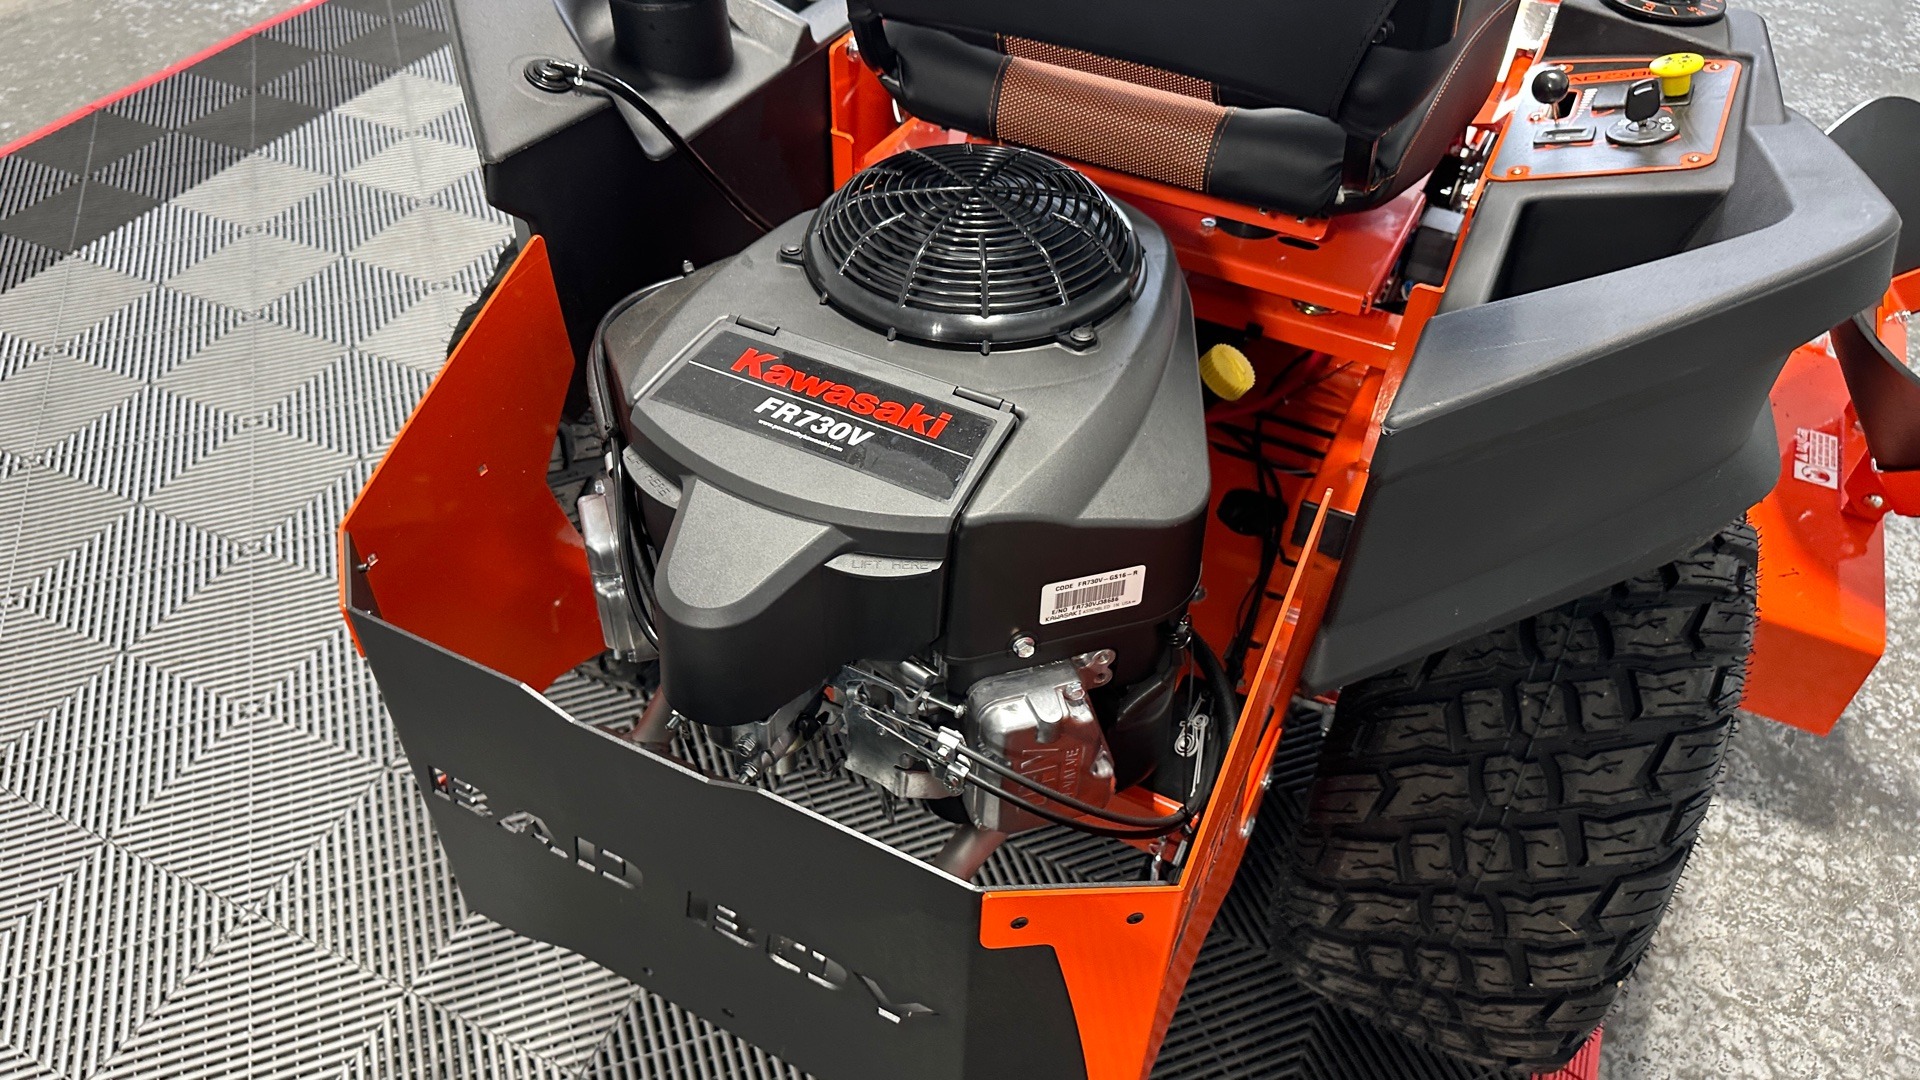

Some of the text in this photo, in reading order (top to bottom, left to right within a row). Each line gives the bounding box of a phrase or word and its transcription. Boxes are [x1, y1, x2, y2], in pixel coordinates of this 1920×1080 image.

[731, 347, 953, 440] Kawasaki
[753, 397, 875, 447] FR730V
[851, 559, 929, 570] LIFT HERE
[1055, 583, 1074, 592] CODE
[1045, 610, 1082, 622] KAWASAKI
[1051, 607, 1068, 615] E/NO
[427, 765, 940, 1024] BAD BOY
